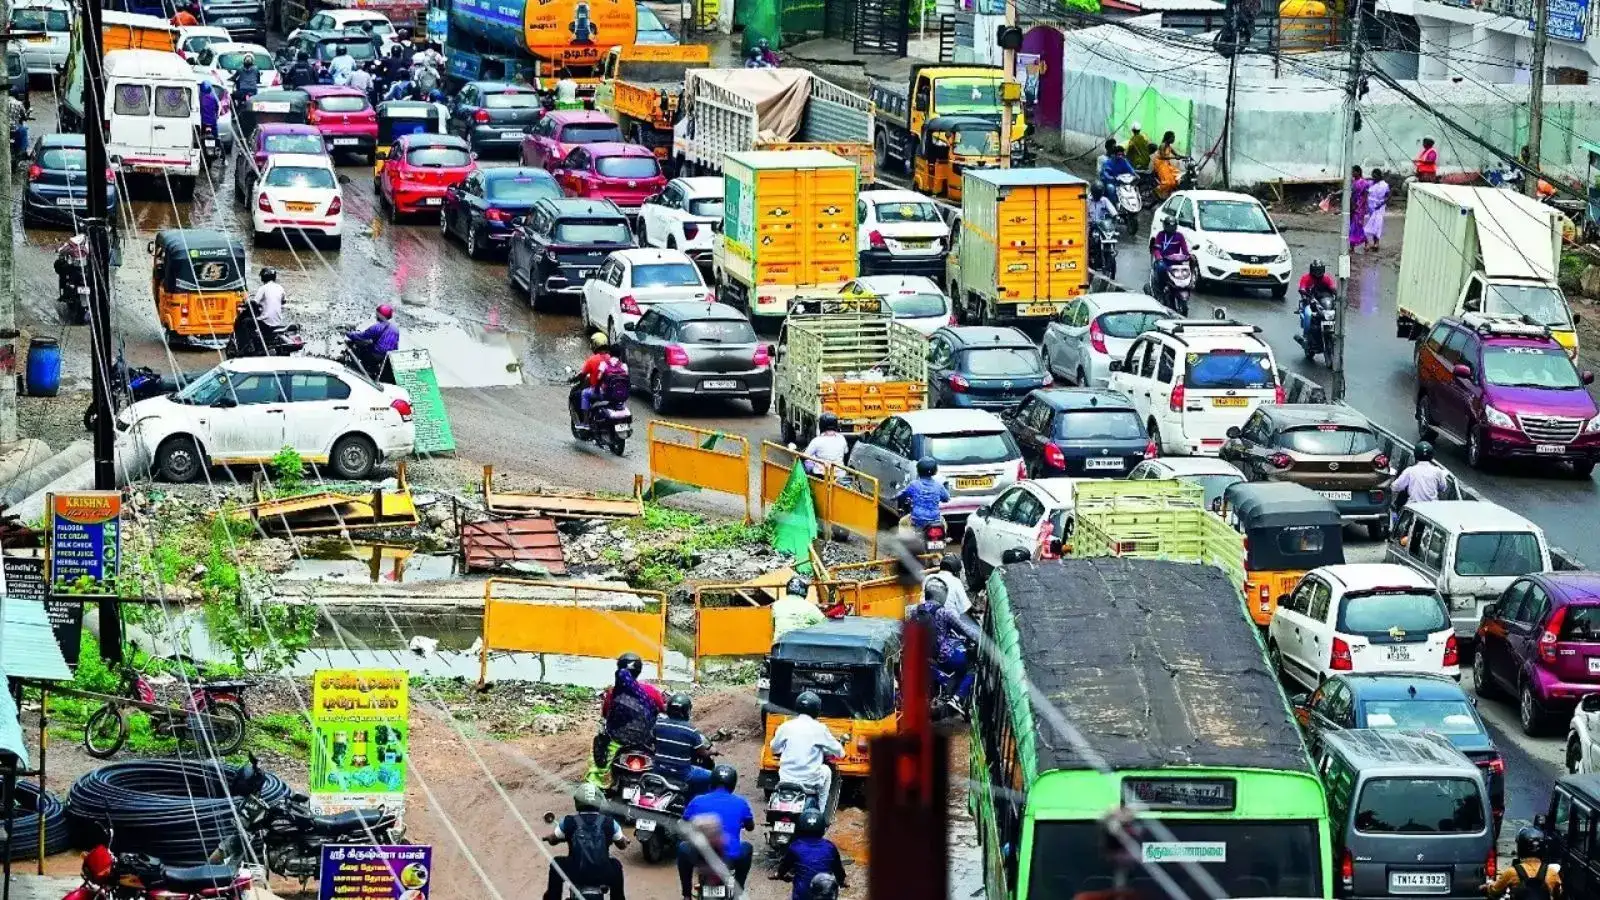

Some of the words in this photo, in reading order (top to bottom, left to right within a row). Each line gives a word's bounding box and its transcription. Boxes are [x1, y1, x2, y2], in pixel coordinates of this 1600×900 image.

[863, 403, 882, 411] TATA
[65, 496, 111, 509] KRISHNA
[4, 563, 37, 572] Gandhi's
[397, 848, 426, 860] பவன்
[1397, 875, 1417, 885] TN14
